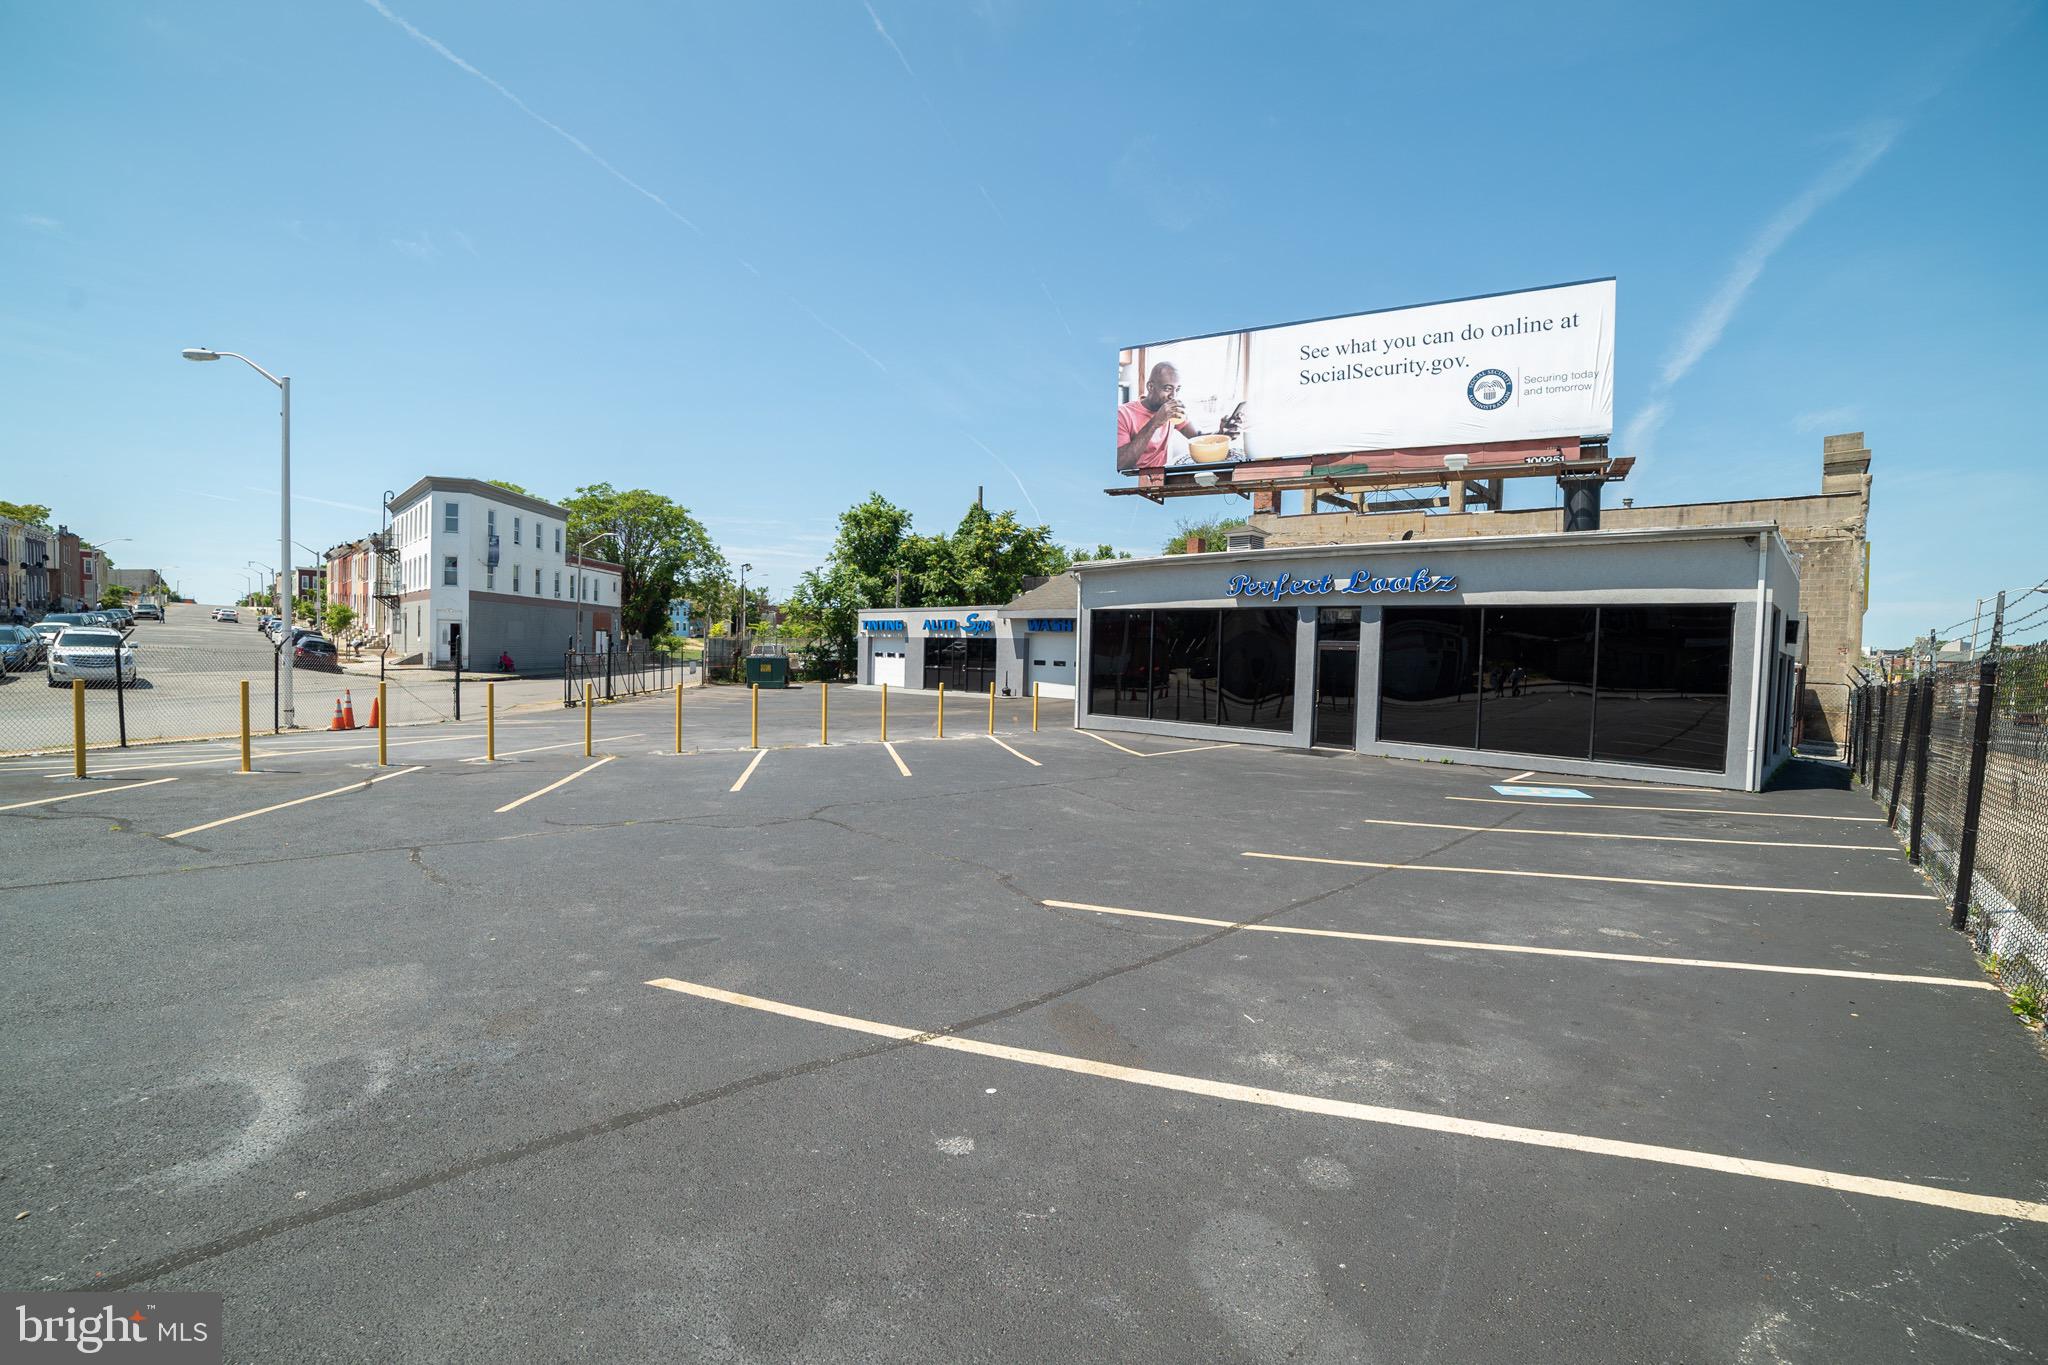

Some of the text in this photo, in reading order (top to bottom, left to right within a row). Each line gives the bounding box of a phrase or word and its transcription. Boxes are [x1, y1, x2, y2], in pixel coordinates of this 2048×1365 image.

[1299, 312, 1580, 360] See what you can do online at
[1299, 355, 1470, 386] SocialSecurity.gov.
[1523, 369, 1599, 385] Securing today
[1523, 383, 1593, 396] and tomorrow
[1468, 391, 1511, 410] ADMINISTRATION
[1225, 567, 1458, 602] Perfect Lookz
[862, 619, 904, 632] TINTING
[922, 613, 992, 636] AUTO Spa
[1027, 618, 1073, 632] WASH
